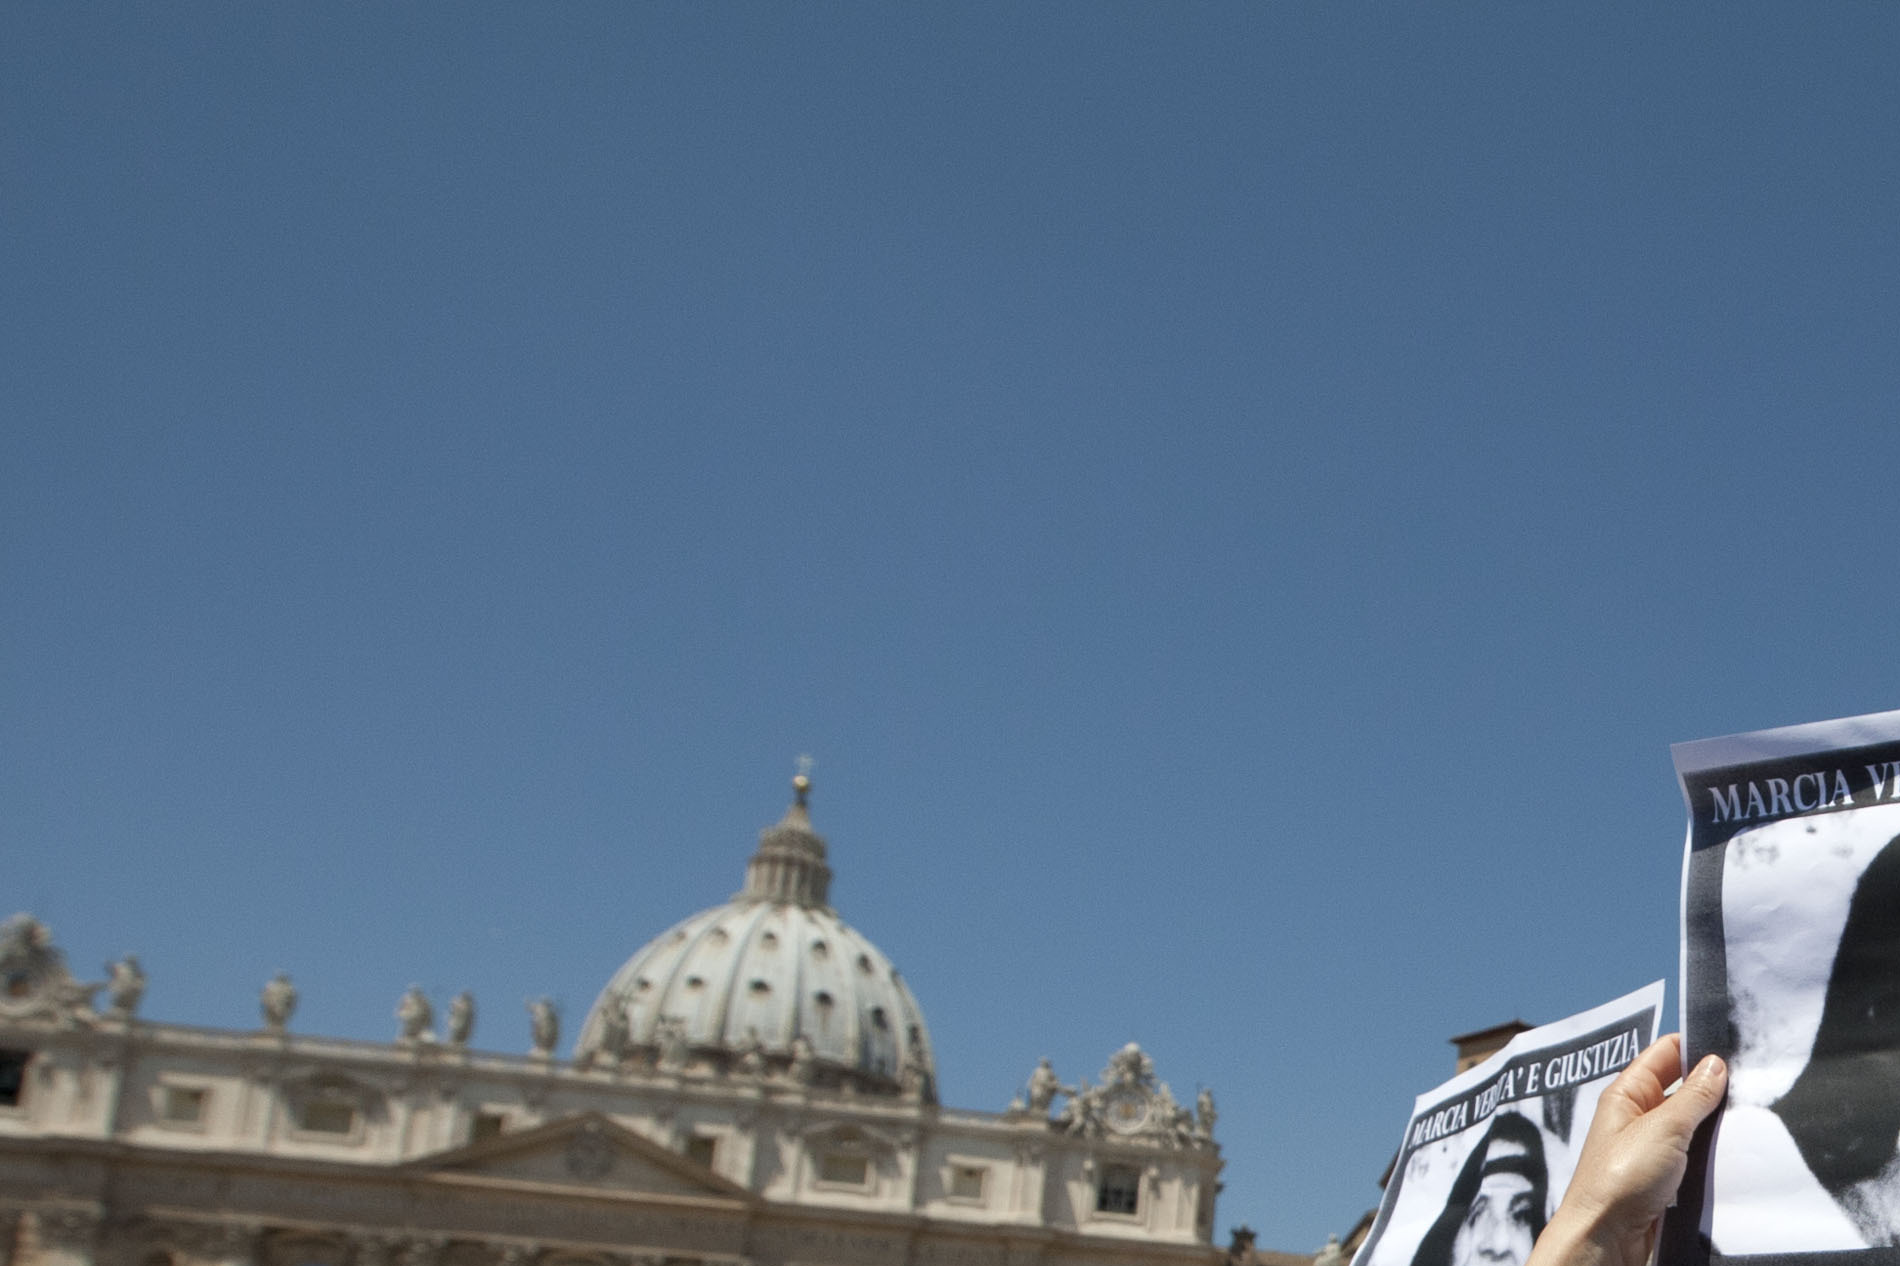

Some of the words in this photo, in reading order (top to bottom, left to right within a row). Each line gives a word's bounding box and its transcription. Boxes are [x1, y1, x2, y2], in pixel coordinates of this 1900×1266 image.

[1708, 768, 1855, 823] MARCIA
[1408, 1099, 1469, 1149] MARCIA
[1525, 1061, 1542, 1094] E
[1544, 1027, 1641, 1089] GIUSTIZIA
